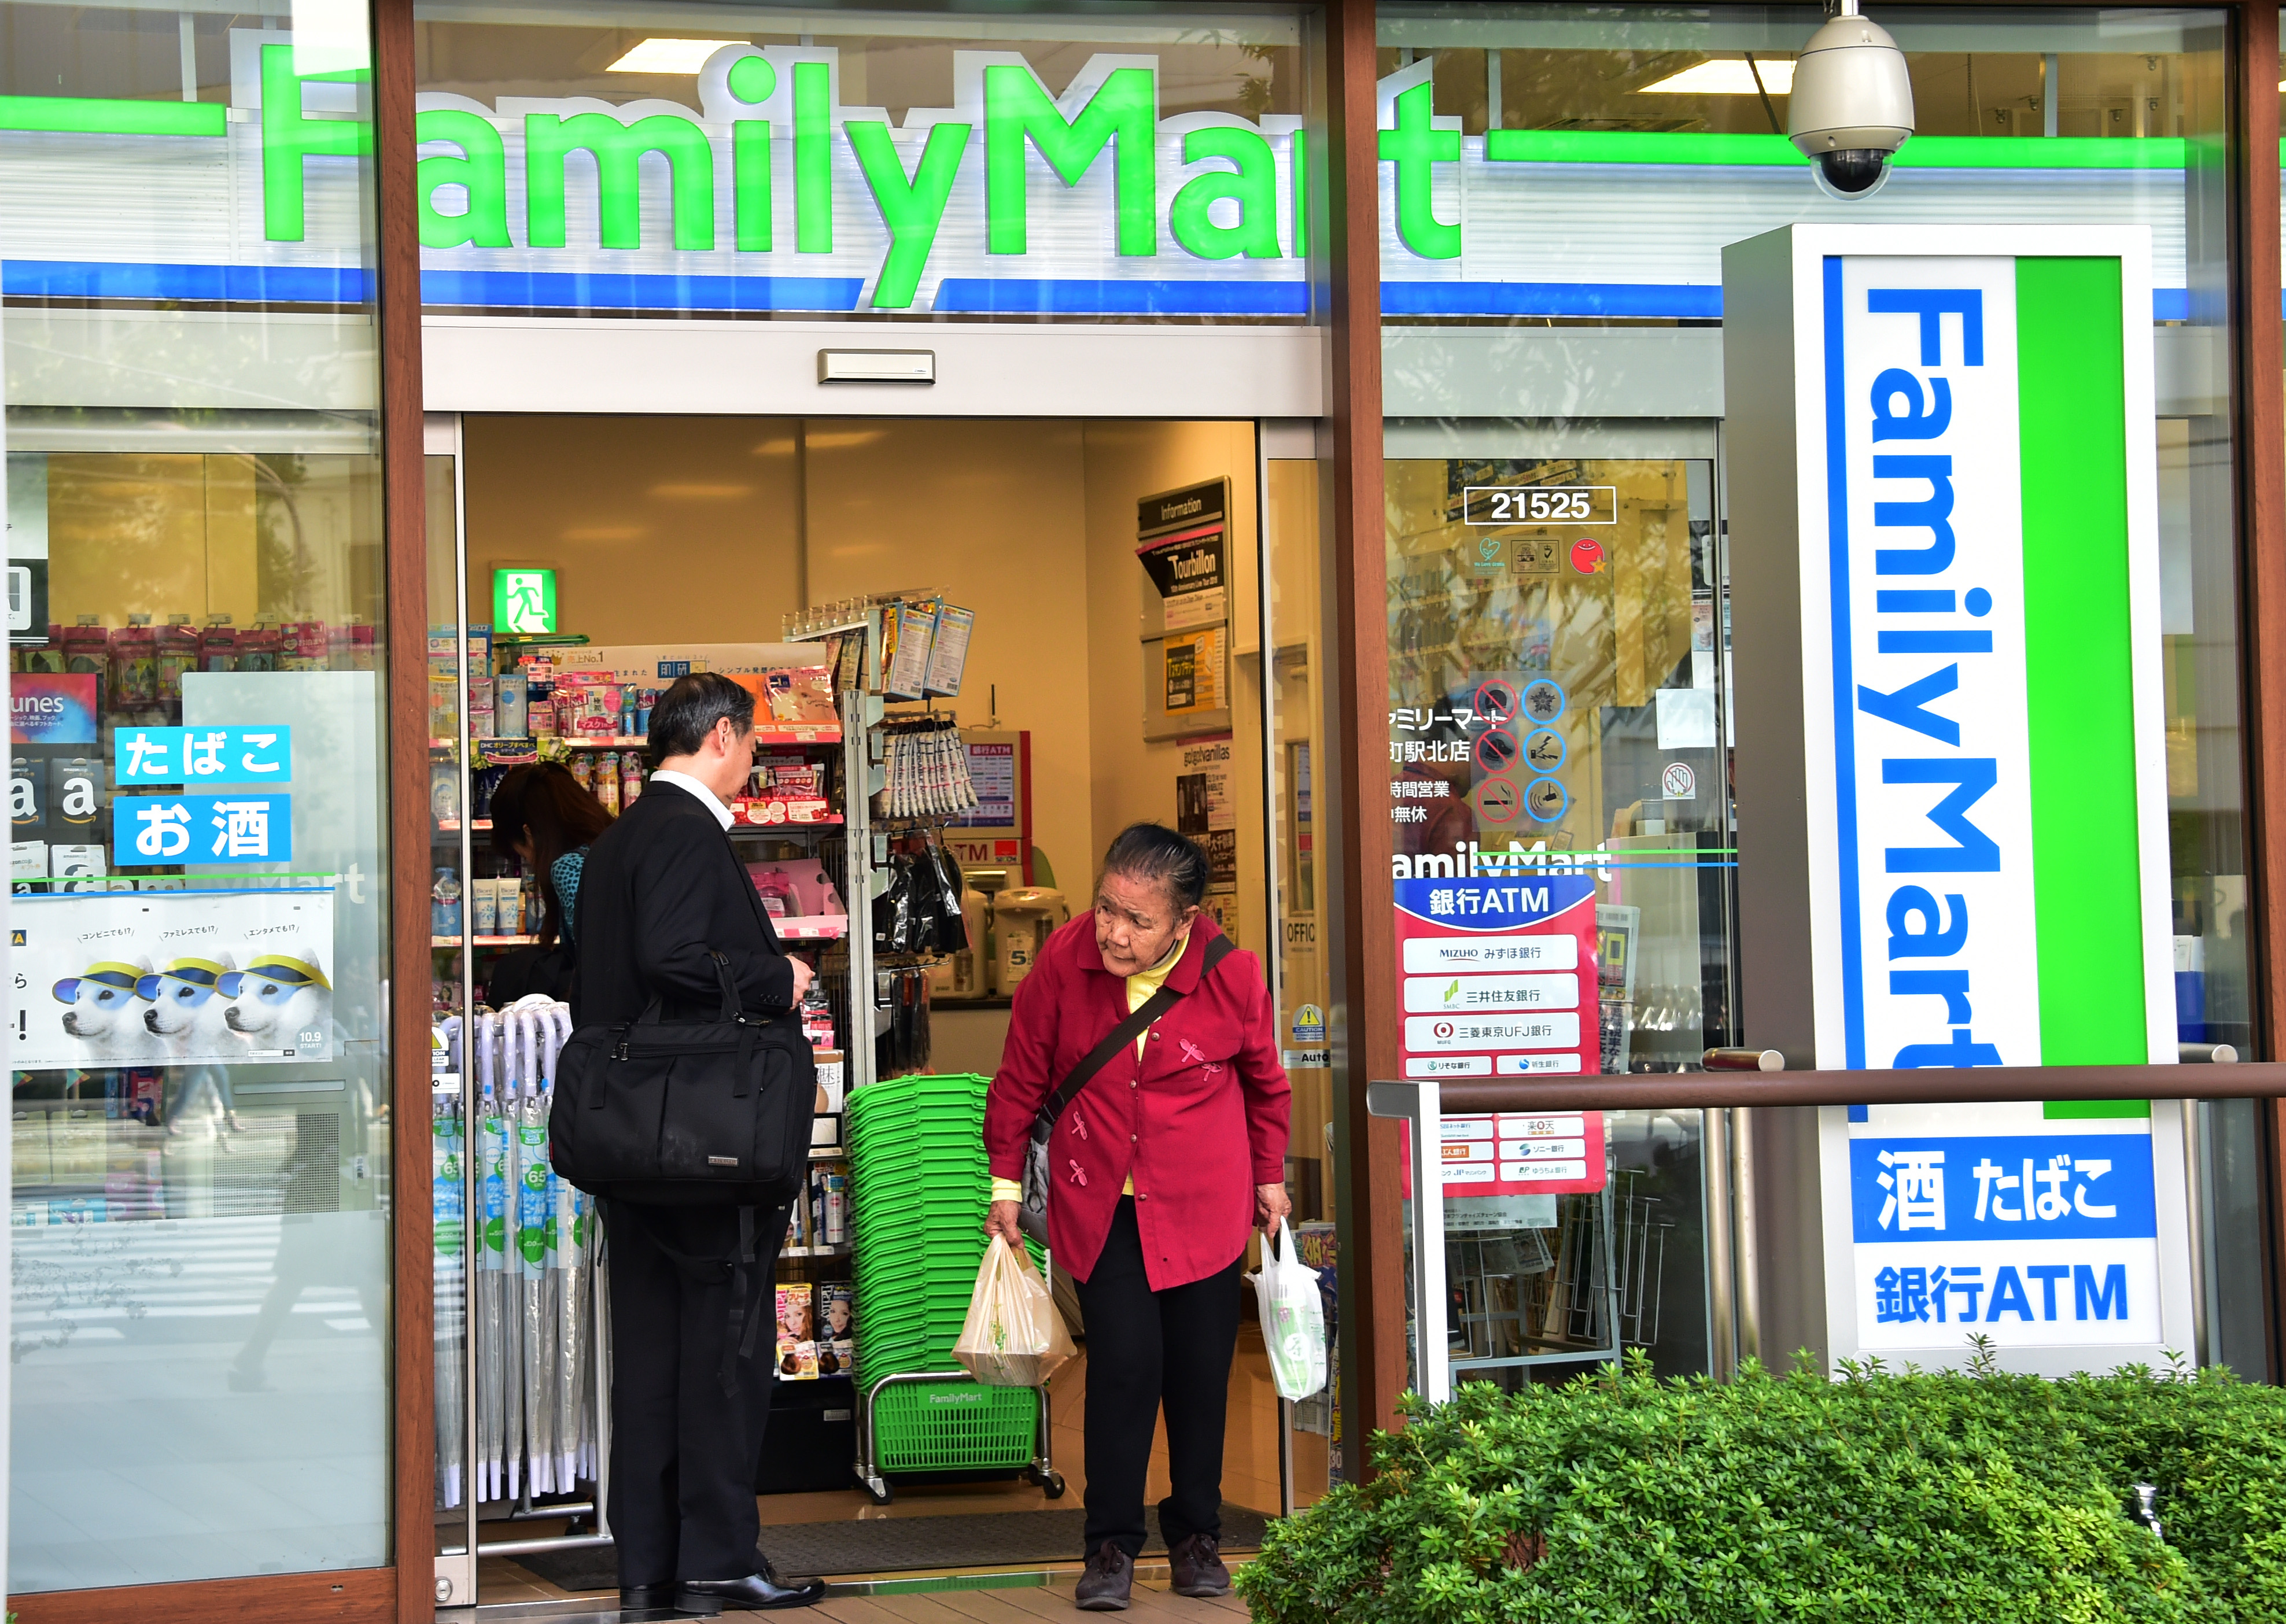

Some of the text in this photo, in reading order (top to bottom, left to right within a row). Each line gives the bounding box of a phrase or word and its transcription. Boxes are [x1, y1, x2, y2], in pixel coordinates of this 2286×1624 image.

[1162, 497, 1201, 520] Information
[1491, 493, 1591, 519] 21525
[1167, 549, 1216, 580] Tourbillon
[1858, 289, 2003, 1069] FamilyMart
[126, 731, 280, 777] たばこ
[136, 800, 270, 857] お酒
[1429, 887, 1549, 916] 銀行ATM
[1011, 950, 1027, 965] 5
[1439, 947, 1542, 959] MIZUHO みずほ銀行
[1466, 989, 1540, 1004] 三井住友銀行
[299, 1032, 322, 1042] 10.9
[1459, 1025, 1552, 1039] 三菱東京UFJ銀行
[1301, 1053, 1329, 1062] Auto
[1531, 1060, 1559, 1068] 新生銀行
[1438, 1061, 1470, 1070] りそな銀行
[528, 1171, 546, 1182] 65
[1876, 1149, 2117, 1231] 酒 たばこ
[1874, 1264, 2128, 1324] 銀行ATM
[930, 1392, 982, 1404] FamilyMart
